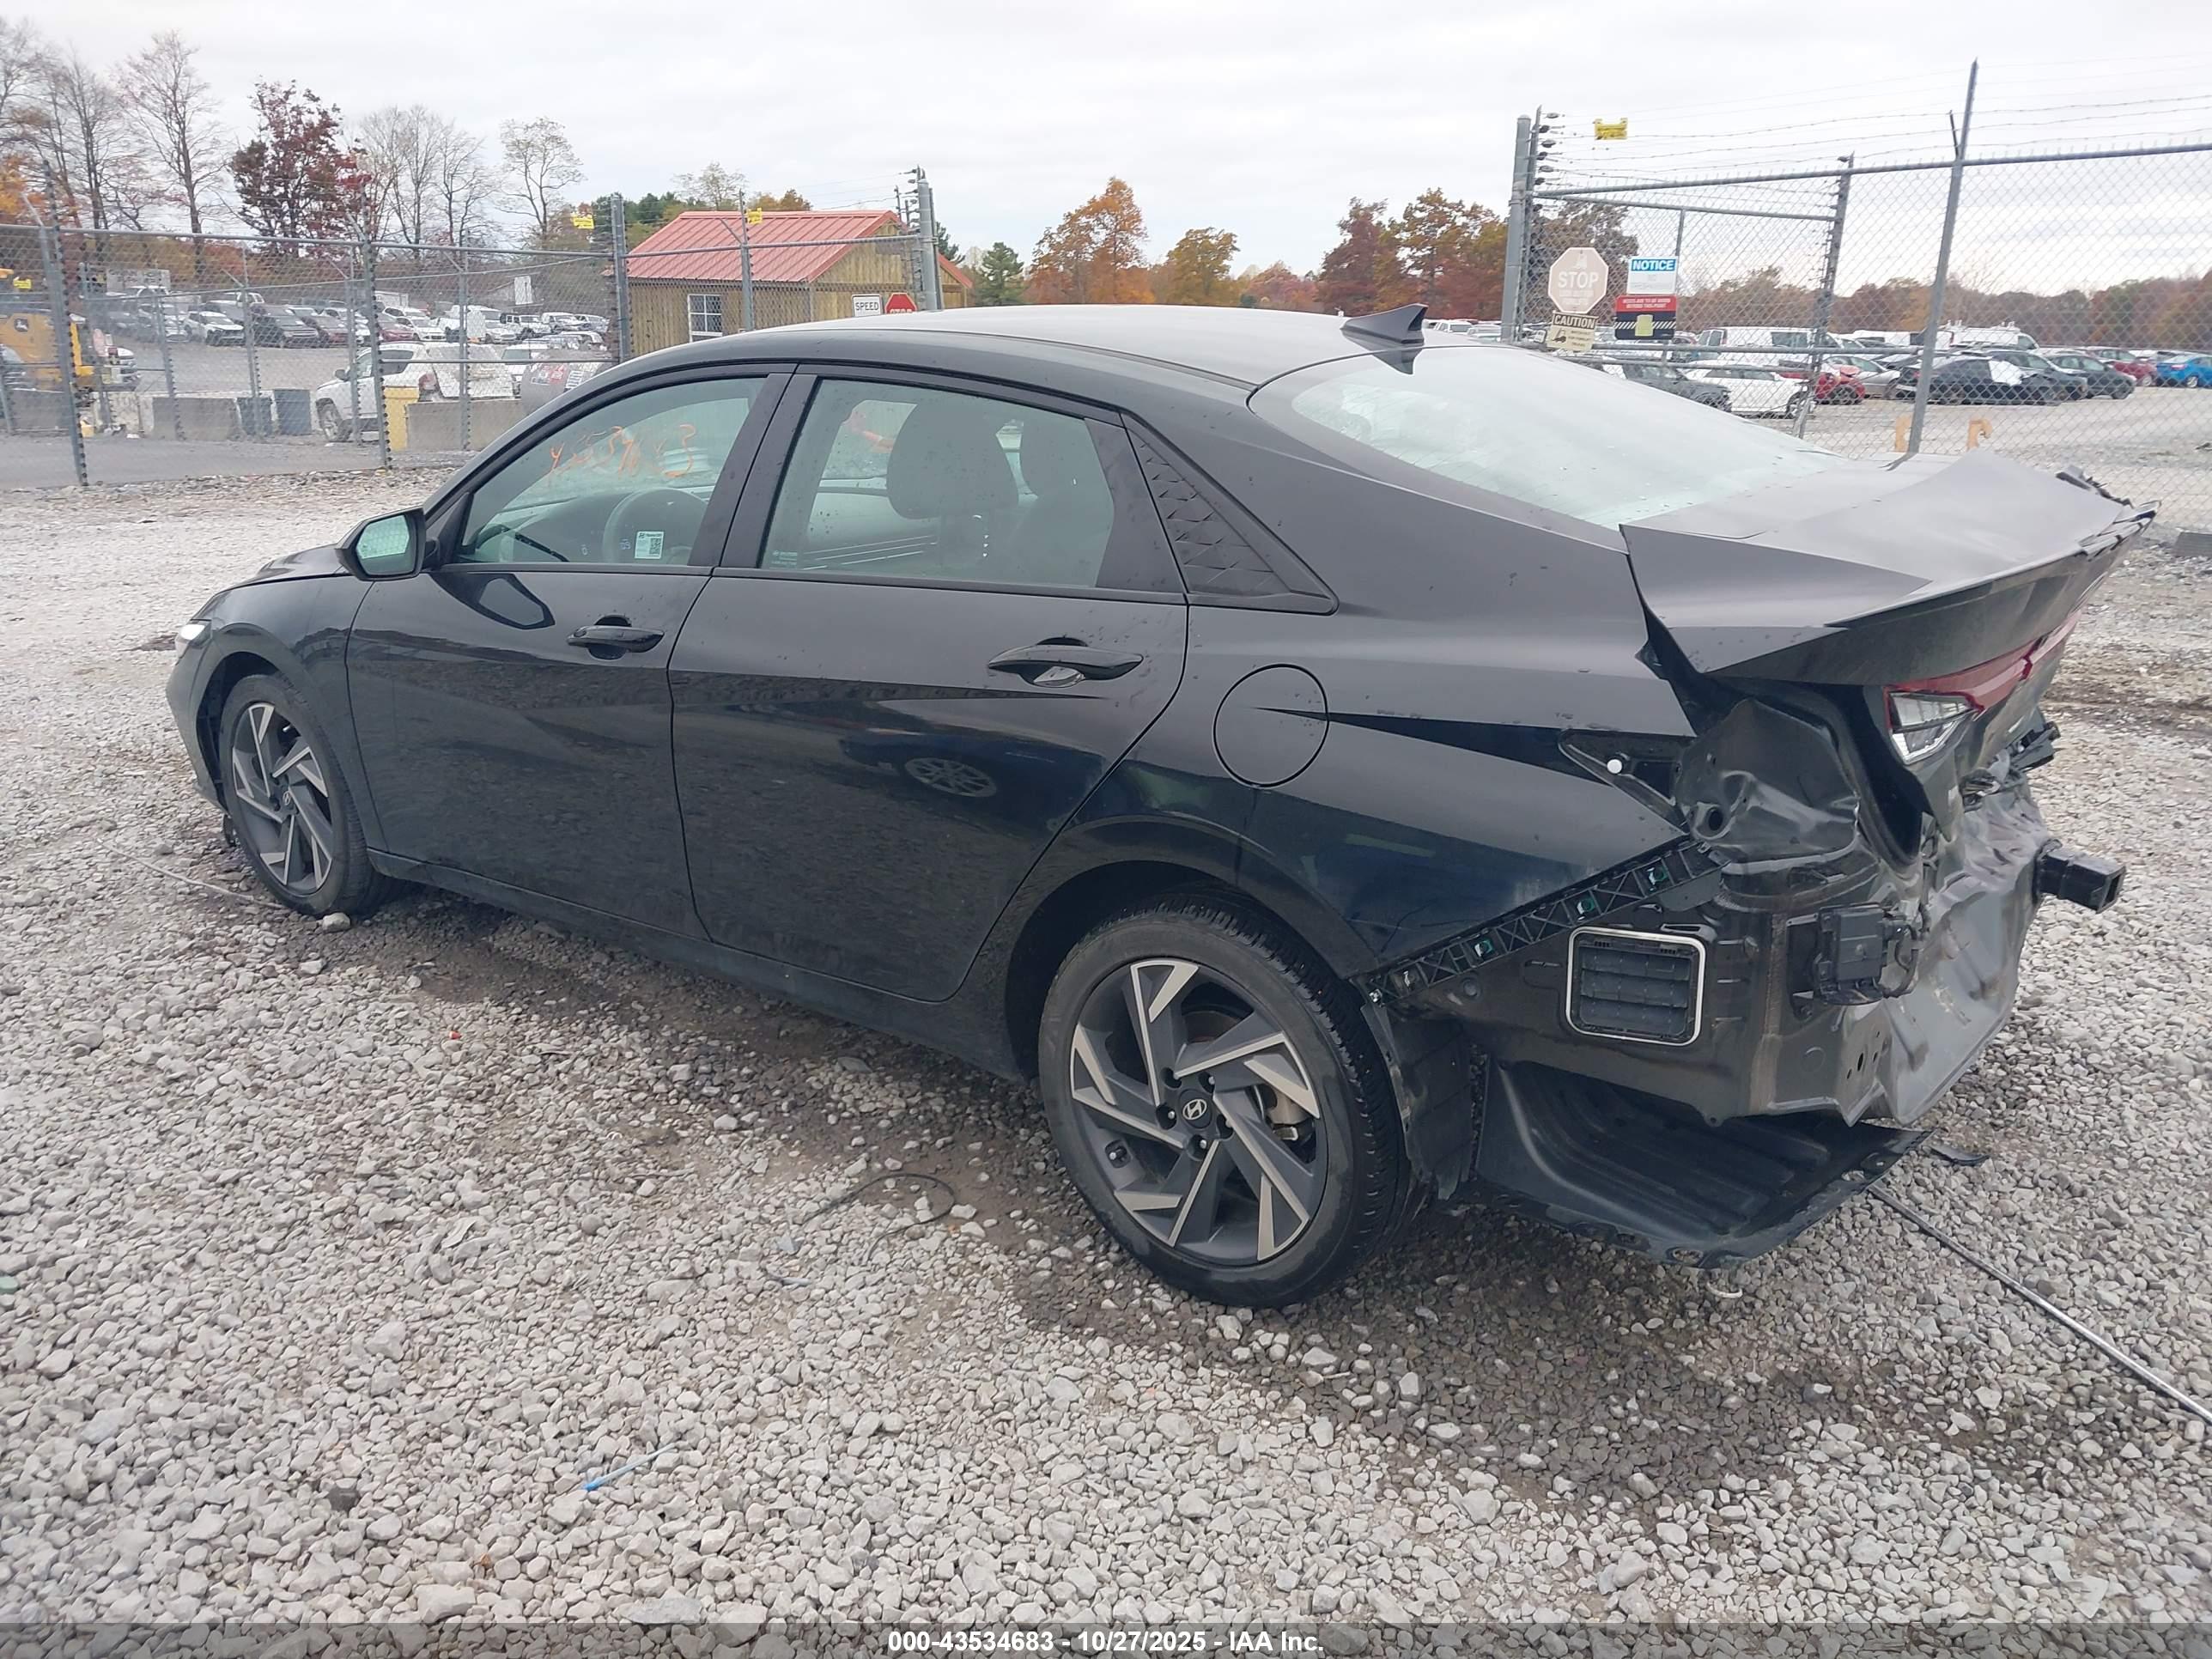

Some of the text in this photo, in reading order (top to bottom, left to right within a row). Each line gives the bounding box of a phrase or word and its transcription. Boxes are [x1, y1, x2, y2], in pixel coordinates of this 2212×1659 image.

[1632, 259, 1674, 270] NOTICE
[1558, 270, 1600, 289] STOP
[855, 301, 879, 311] SPEED
[1554, 314, 1595, 329] CAUTION
